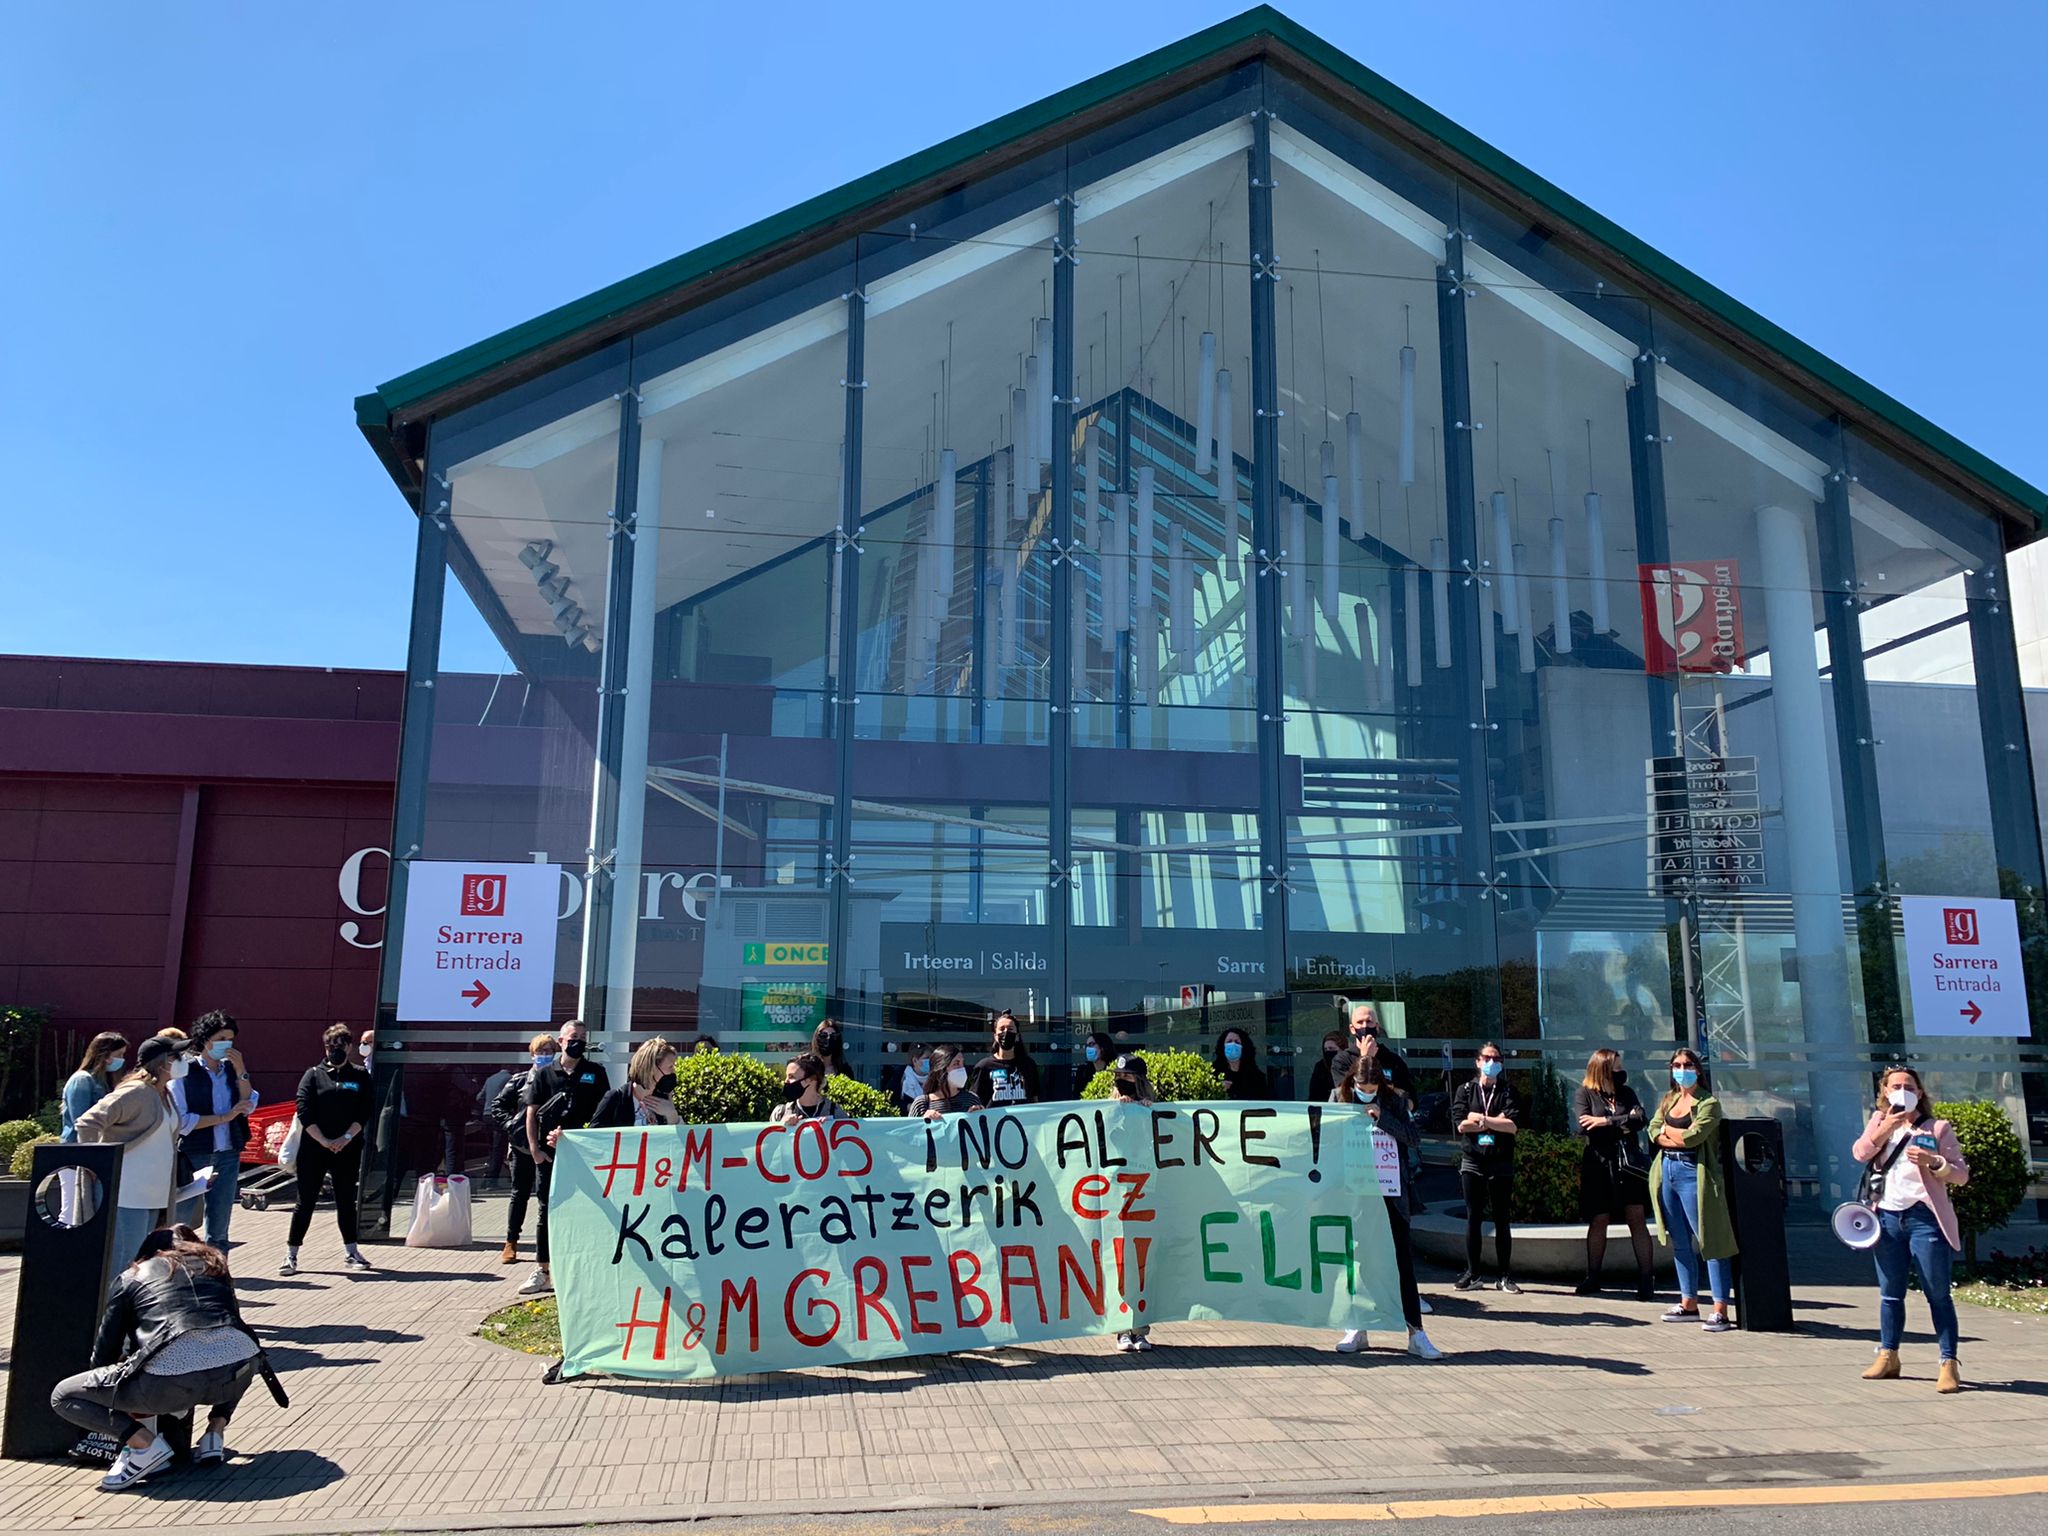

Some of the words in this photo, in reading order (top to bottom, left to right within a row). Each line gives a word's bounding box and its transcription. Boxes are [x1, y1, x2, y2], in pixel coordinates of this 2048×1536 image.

[476, 878, 501, 912] g
[437, 924, 523, 946] Sarrera
[1955, 911, 1974, 942] g
[435, 949, 522, 971] Entrada
[773, 946, 828, 961] ONCE
[904, 952, 974, 971] Irteera
[991, 952, 1047, 971] Salida
[1933, 953, 1998, 970] Sarrera
[1217, 956, 1265, 974] Sarre
[1306, 958, 1376, 977] Entrada
[1934, 975, 2001, 992] Entrada
[763, 1005, 814, 1014] JUGAMOS
[771, 1014, 806, 1024] TODOS
[594, 1120, 873, 1198] H&M-COS
[1057, 1109, 1128, 1170] AL
[612, 1174, 1044, 1265] Kaleratzerik
[1071, 1172, 1156, 1223] ez
[1200, 1209, 1357, 1296] ELA
[86, 1447, 103, 1457] LOS
